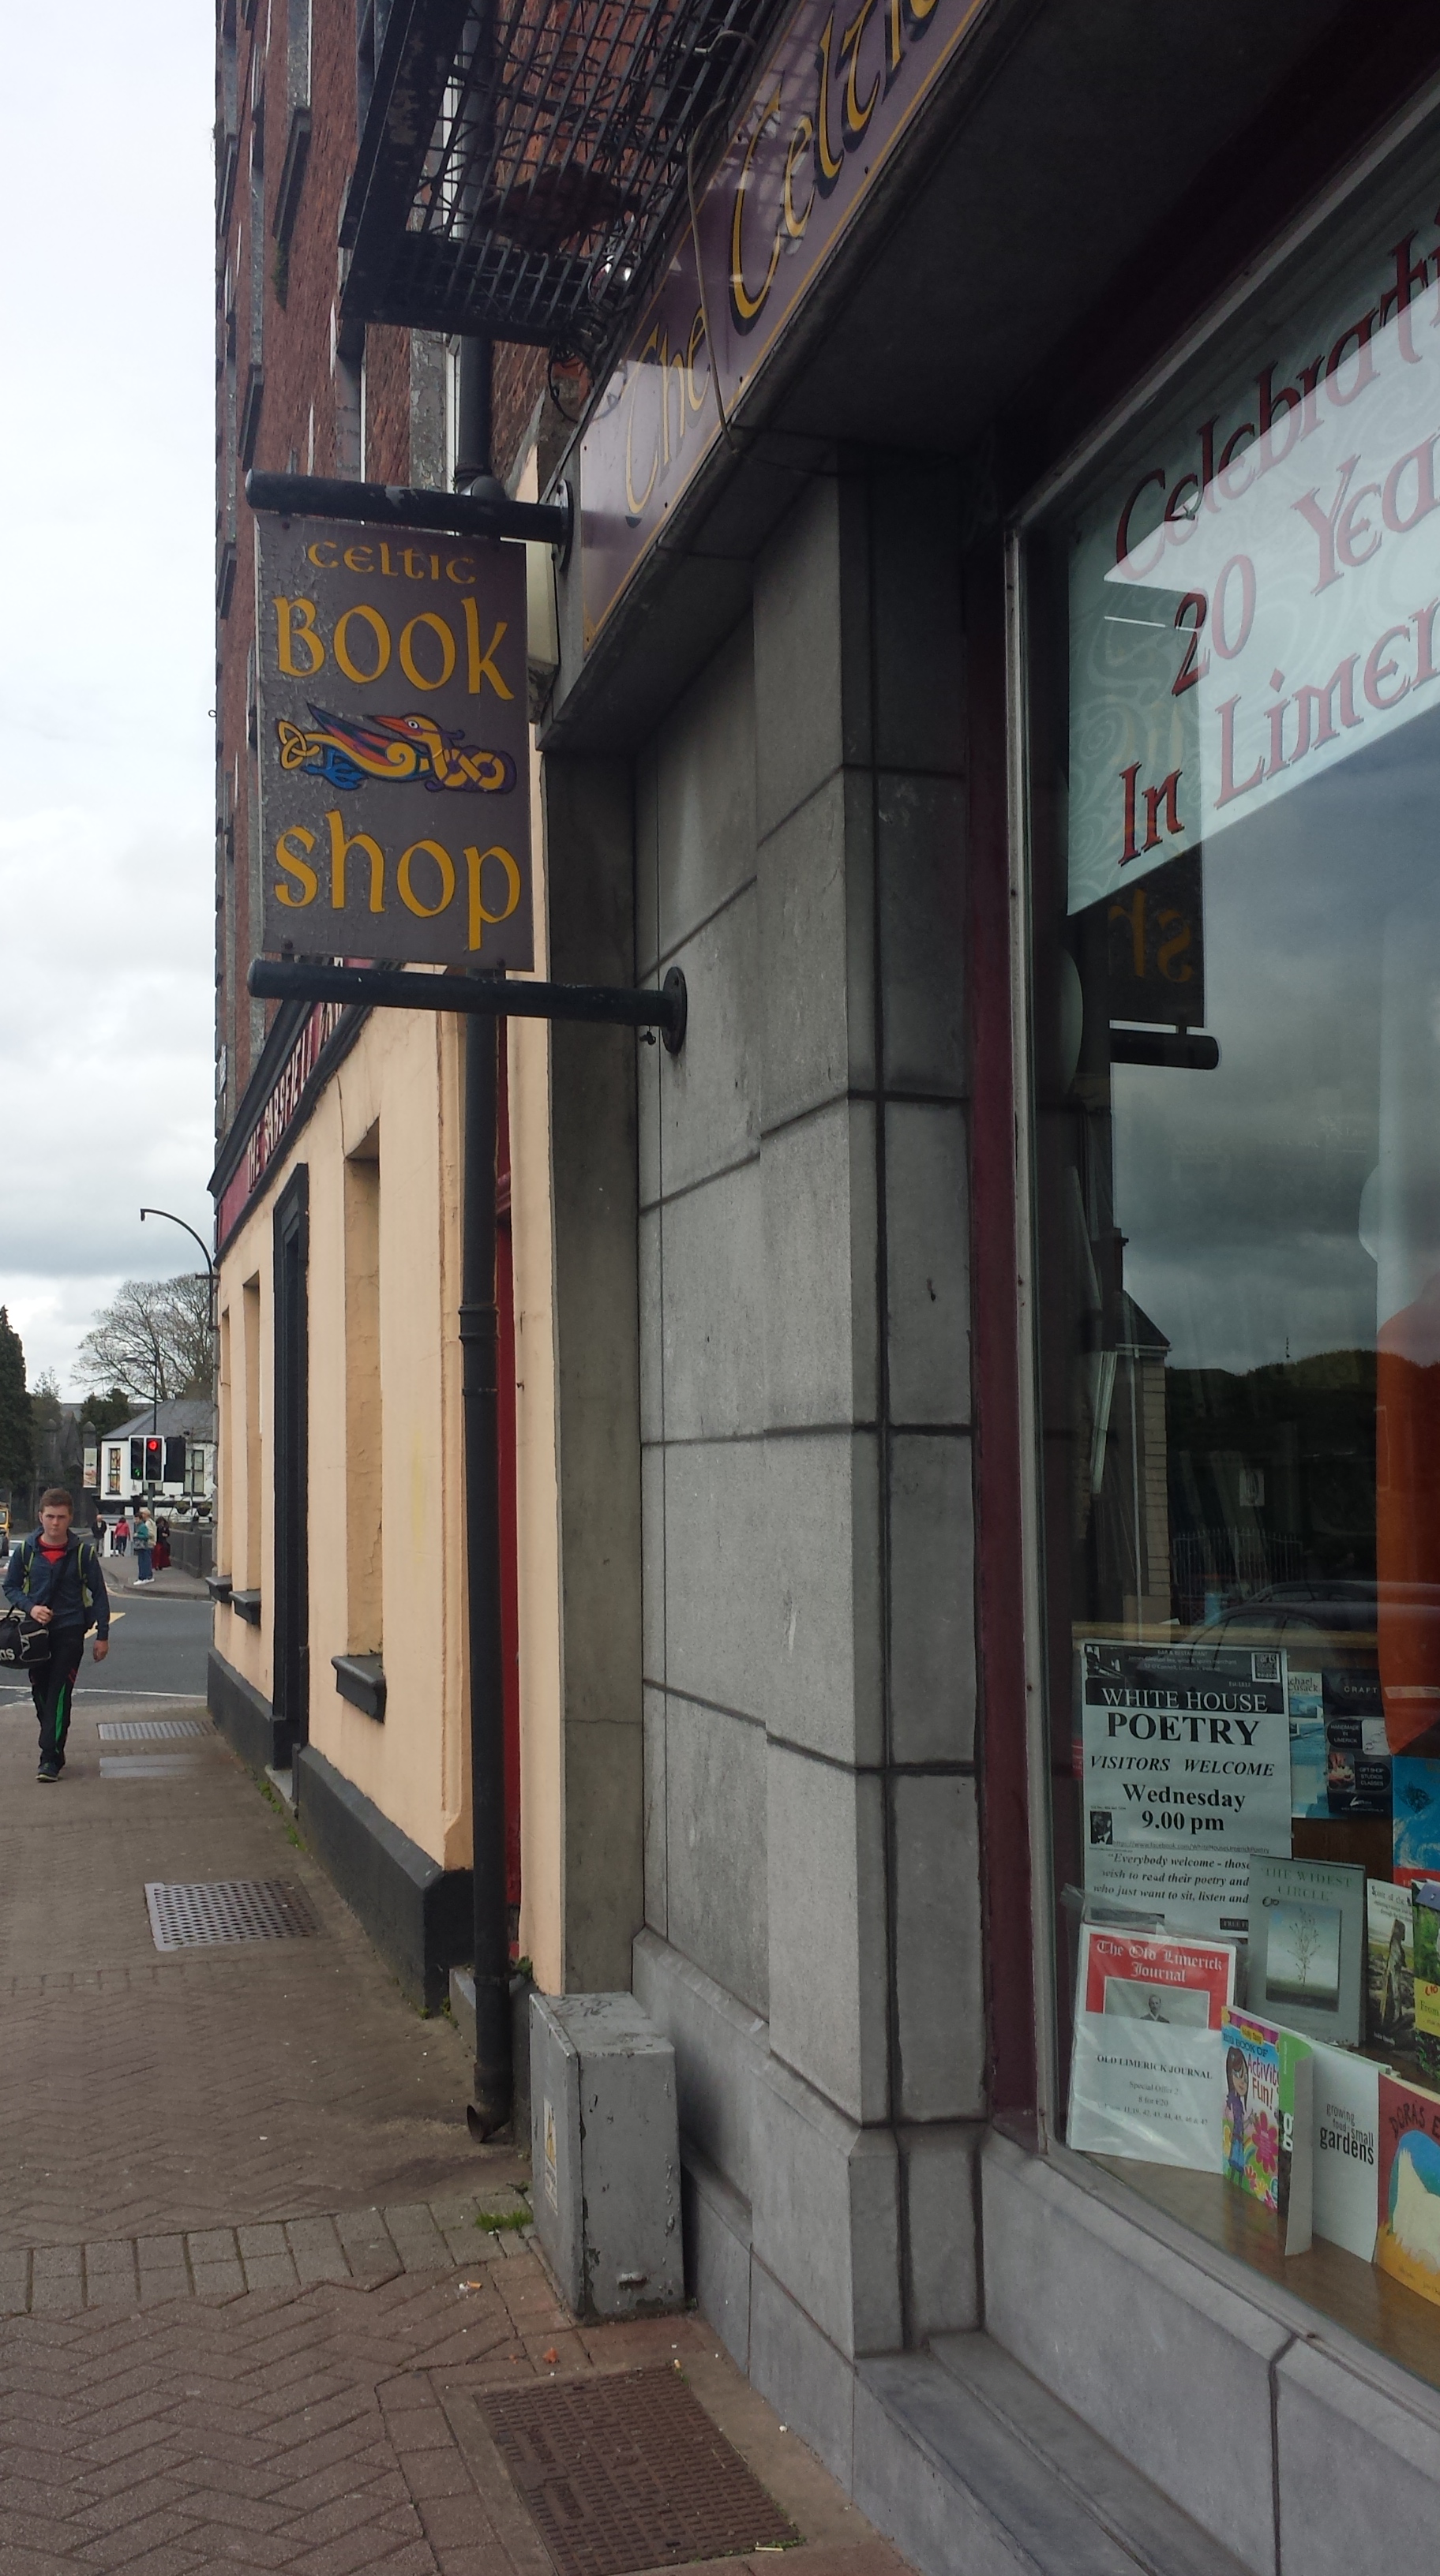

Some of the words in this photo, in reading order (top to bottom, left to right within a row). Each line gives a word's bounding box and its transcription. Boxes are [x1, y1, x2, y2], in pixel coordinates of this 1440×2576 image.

[1172, 554, 1256, 696] 20
[1118, 761, 1184, 867] In
[1101, 1687, 1179, 1709] WHITE
[1186, 1691, 1268, 1713] HOUSE
[1107, 1712, 1261, 1747] POETRY
[1090, 1755, 1171, 1772] VISITORS
[1184, 1758, 1275, 1777] WELCOME
[1122, 1784, 1246, 1813] Wednesday
[1142, 1810, 1185, 1830] 9.00
[1191, 1816, 1225, 1836] pm
[1171, 1856, 1215, 1868] welcome
[1102, 1869, 1126, 1879] wish
[1129, 1871, 1138, 1880] to
[1142, 1872, 1165, 1883] read
[1168, 1874, 1192, 1884] their
[1194, 1876, 1227, 1888] poetry
[1229, 1876, 1250, 1887] and
[1297, 1871, 1352, 1889] WIDEST
[1093, 1884, 1115, 1894] who
[1116, 1885, 1137, 1897] just
[1141, 1889, 1166, 1900] want
[1168, 1890, 1178, 1900] to
[1198, 1891, 1226, 1903] listen
[1229, 1894, 1249, 1904] and
[1097, 1939, 1124, 1956] The
[1129, 1945, 1157, 1961] Old
[1163, 1949, 1223, 1971] Limerick
[1131, 1961, 1186, 1983] Journal
[1236, 2039, 1255, 2054] BOOK
[1258, 2046, 1269, 2058] OF
[1097, 2054, 1117, 2064] OLD
[1119, 2057, 1167, 2072] LIMERICK
[1168, 2065, 1213, 2080] JOURNAL
[1248, 2054, 1279, 2094] Activit
[1130, 2080, 1153, 2091] Special
[1326, 2103, 1356, 2127] growing
[1333, 2118, 1347, 2132] food
[1351, 2127, 1374, 2147] small
[1319, 2127, 1374, 2166] gardens
